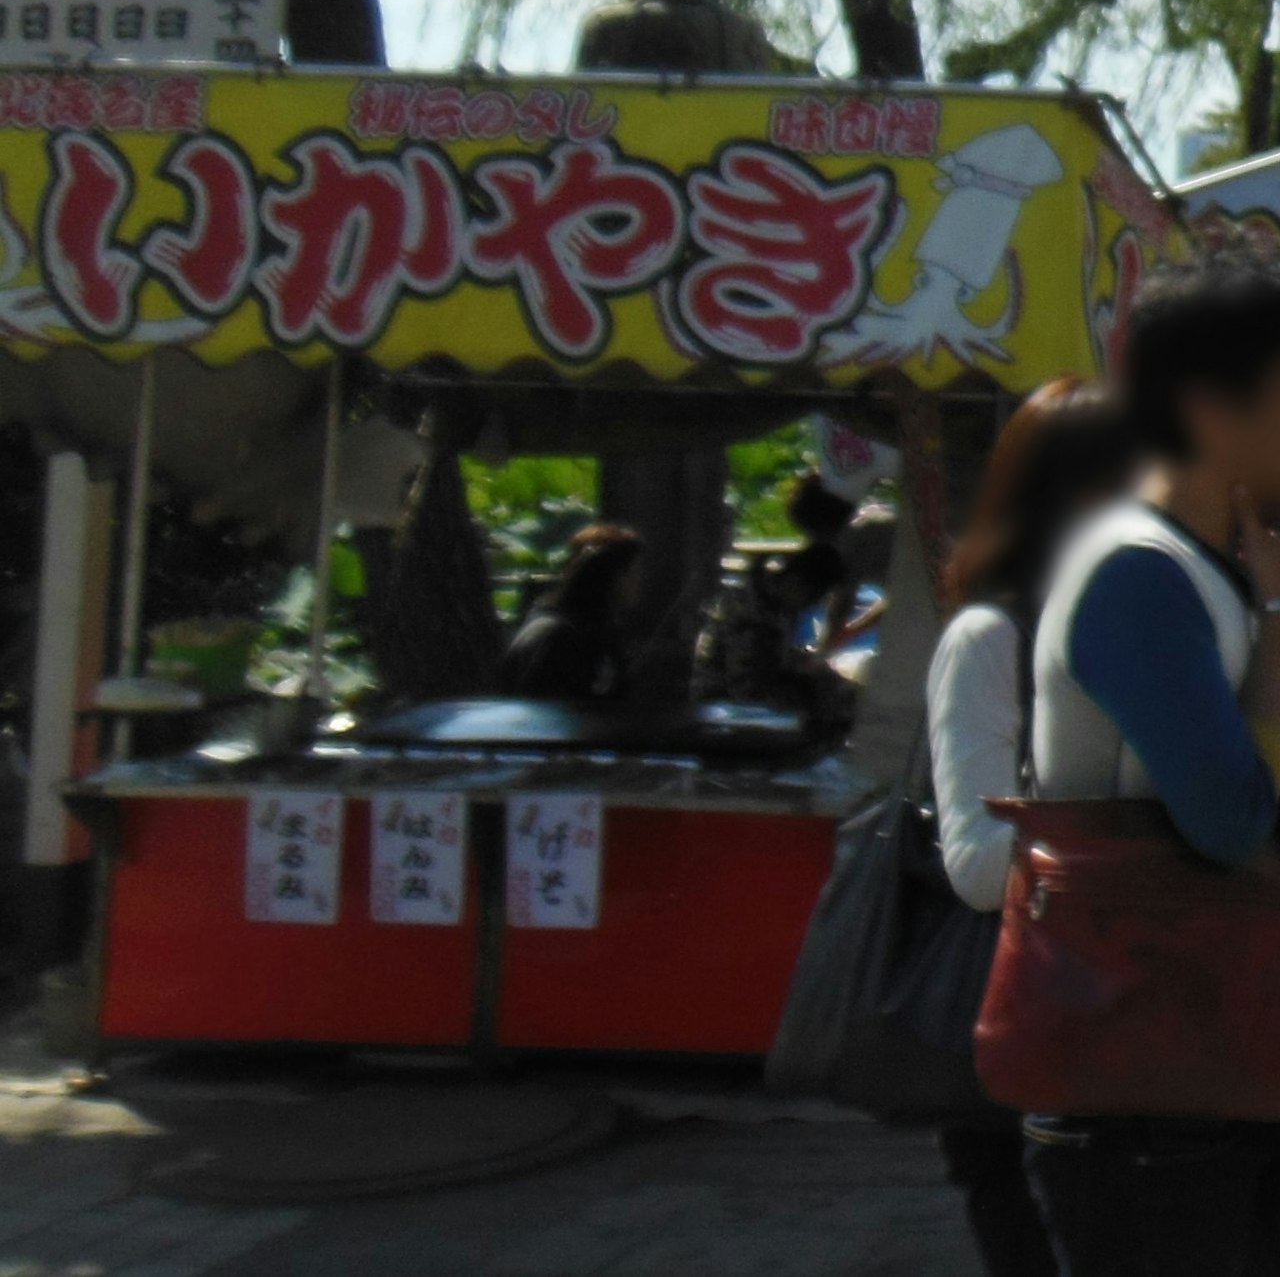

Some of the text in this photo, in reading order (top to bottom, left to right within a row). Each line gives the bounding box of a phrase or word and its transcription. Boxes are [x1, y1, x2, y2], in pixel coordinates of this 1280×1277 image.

[771, 96, 938, 156] 味自慢
[44, 128, 894, 362] いかやき
